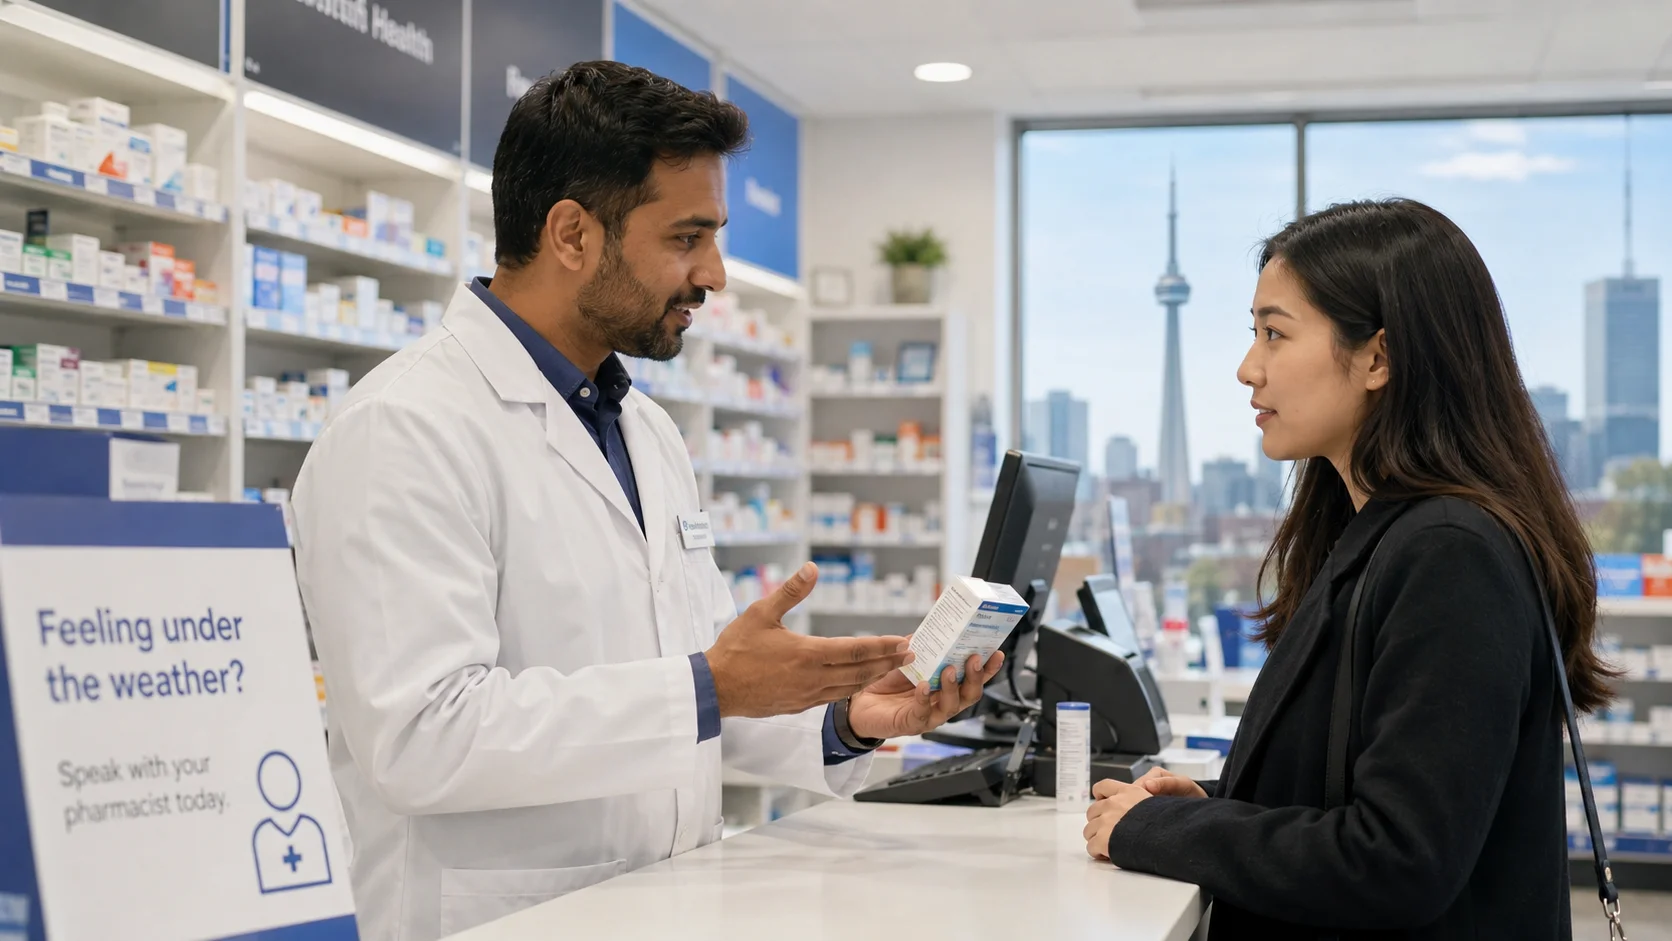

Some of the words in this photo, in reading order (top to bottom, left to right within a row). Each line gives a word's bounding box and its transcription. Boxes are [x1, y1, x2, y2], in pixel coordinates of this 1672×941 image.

[37, 608, 154, 652] Feeling
[162, 608, 243, 642] under
[46, 664, 101, 703] the
[109, 659, 244, 699] weather?
[57, 758, 123, 791] Speak
[128, 755, 168, 780] with
[172, 756, 210, 783] your
[64, 793, 172, 833] pharmacist
[176, 788, 231, 815] today.
